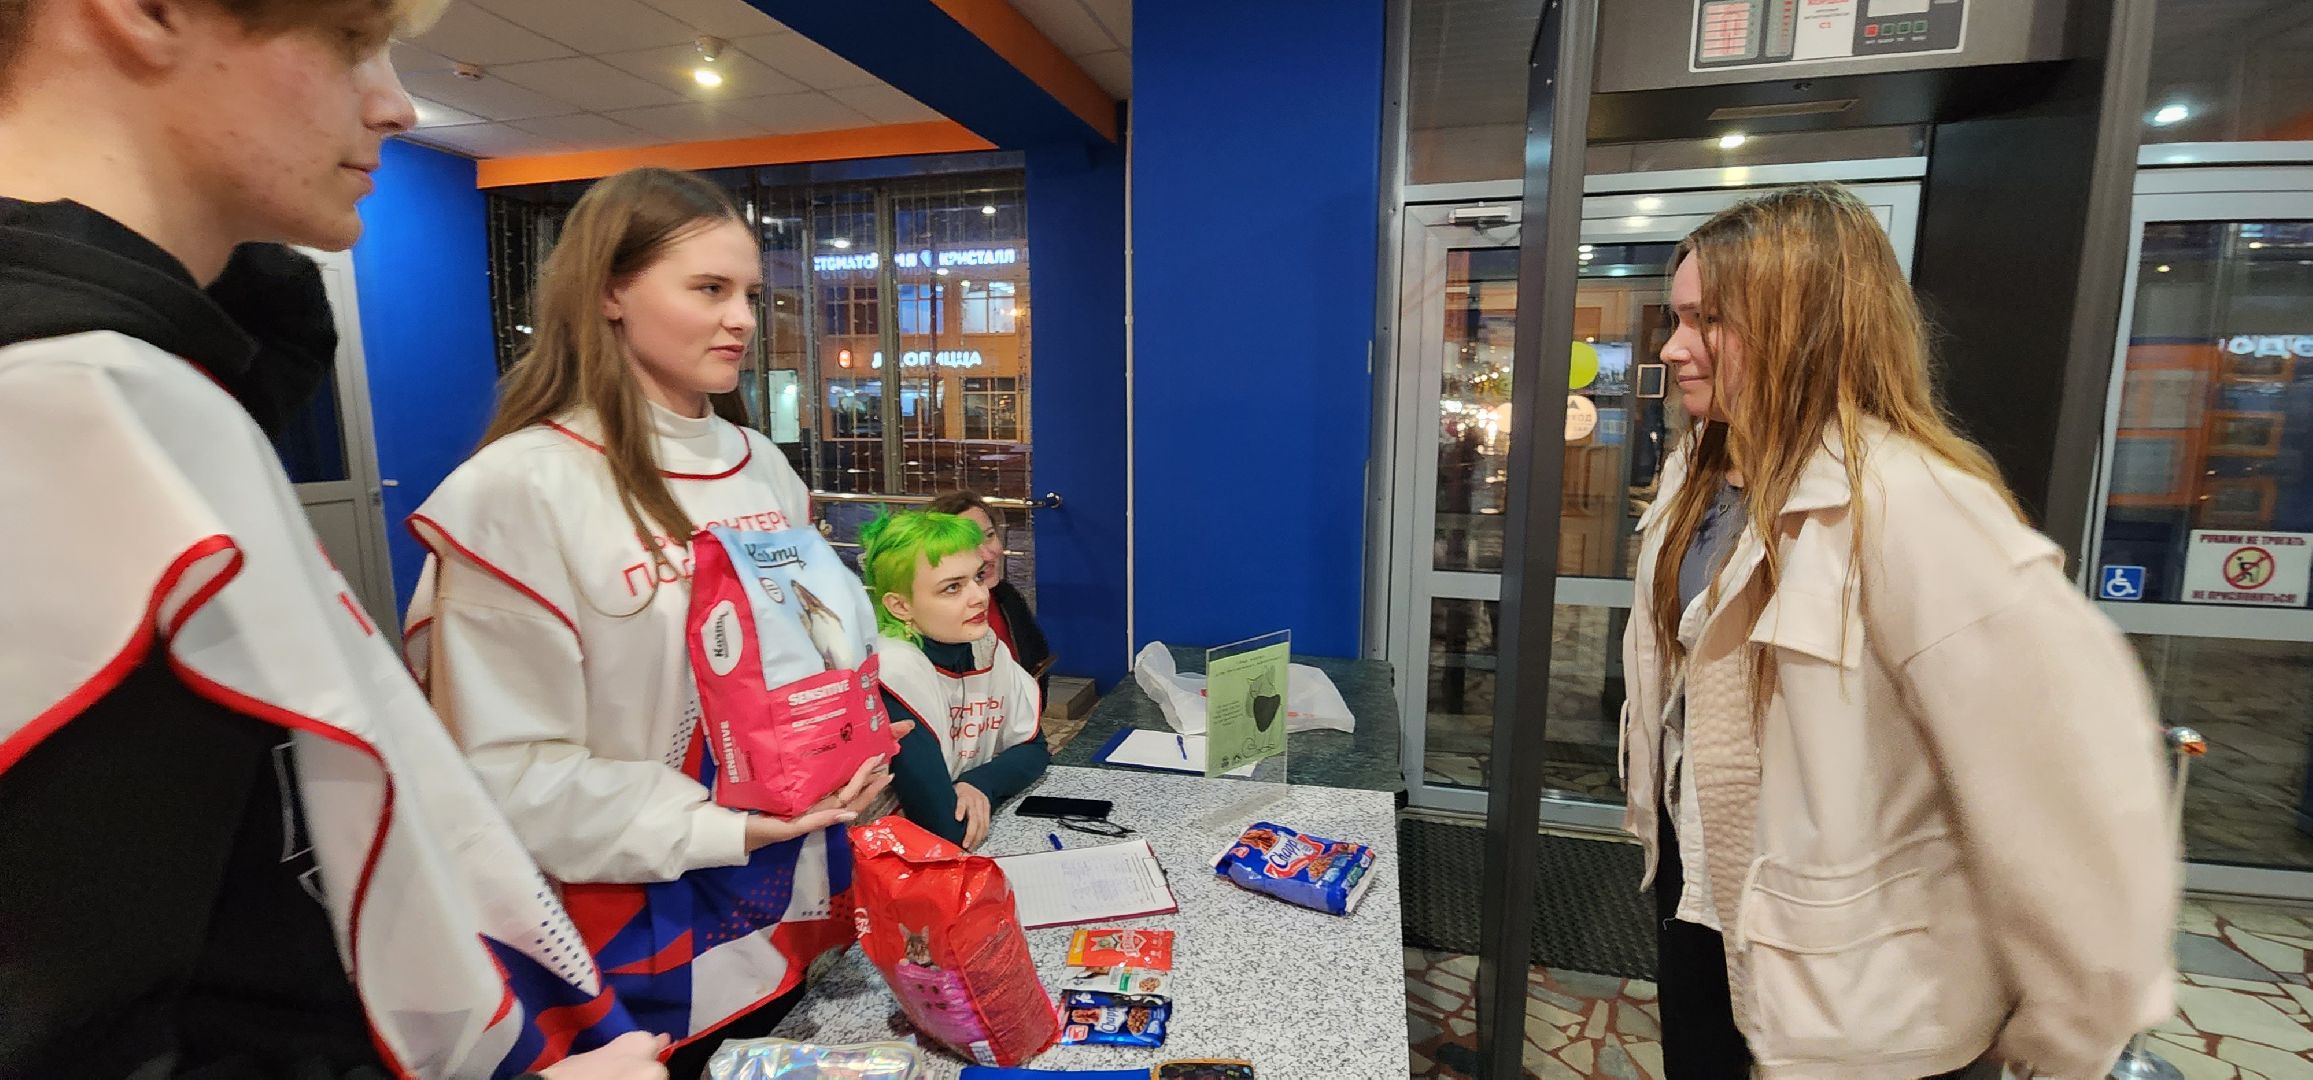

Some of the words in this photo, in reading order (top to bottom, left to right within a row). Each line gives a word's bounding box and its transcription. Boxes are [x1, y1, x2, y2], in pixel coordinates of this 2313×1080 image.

[938, 248, 1016, 266] КРИСТАЛЛ
[2246, 535, 2258, 545] НЕ
[2191, 590, 2204, 600] НЕ
[788, 678, 850, 706] SENSITIVE
[720, 719, 740, 784] SENSITIVE
